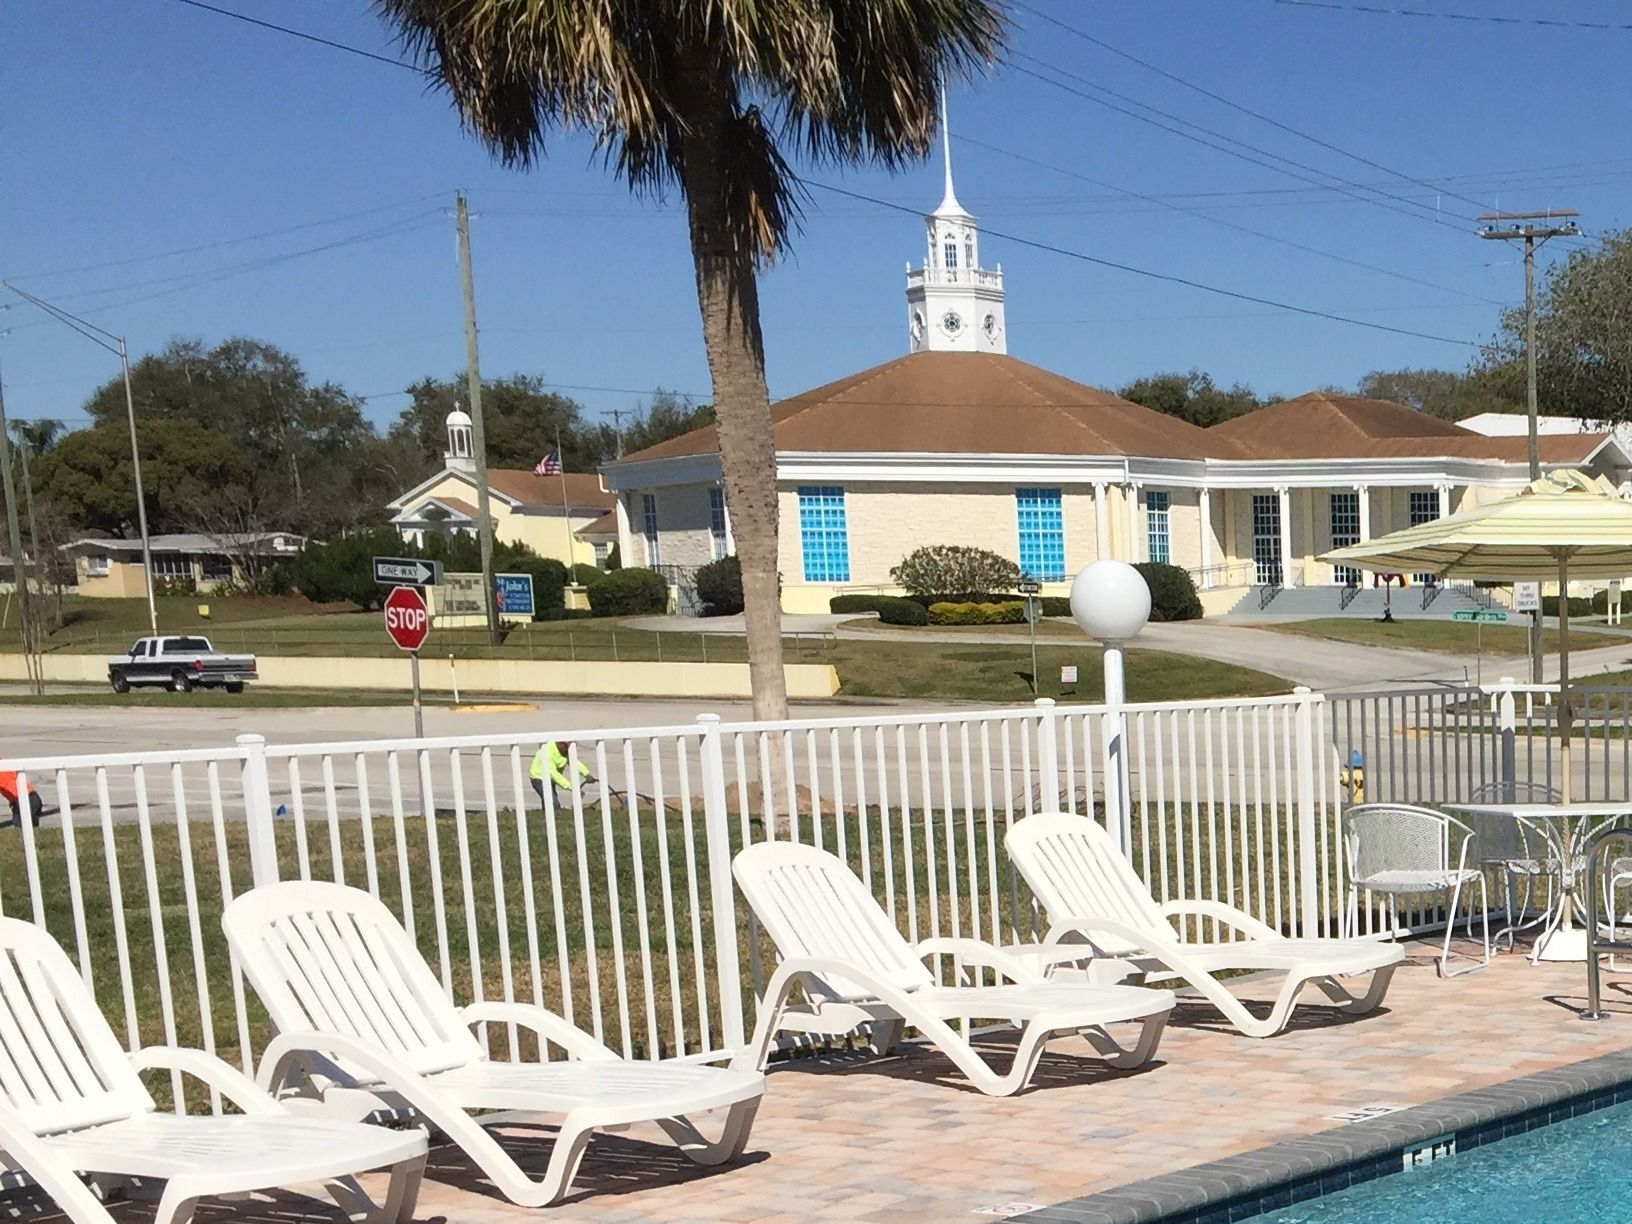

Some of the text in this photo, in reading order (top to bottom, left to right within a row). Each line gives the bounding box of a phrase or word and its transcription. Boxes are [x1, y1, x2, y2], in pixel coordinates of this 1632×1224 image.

[381, 565, 417, 577] ONE WAY
[387, 606, 426, 631] STOP
